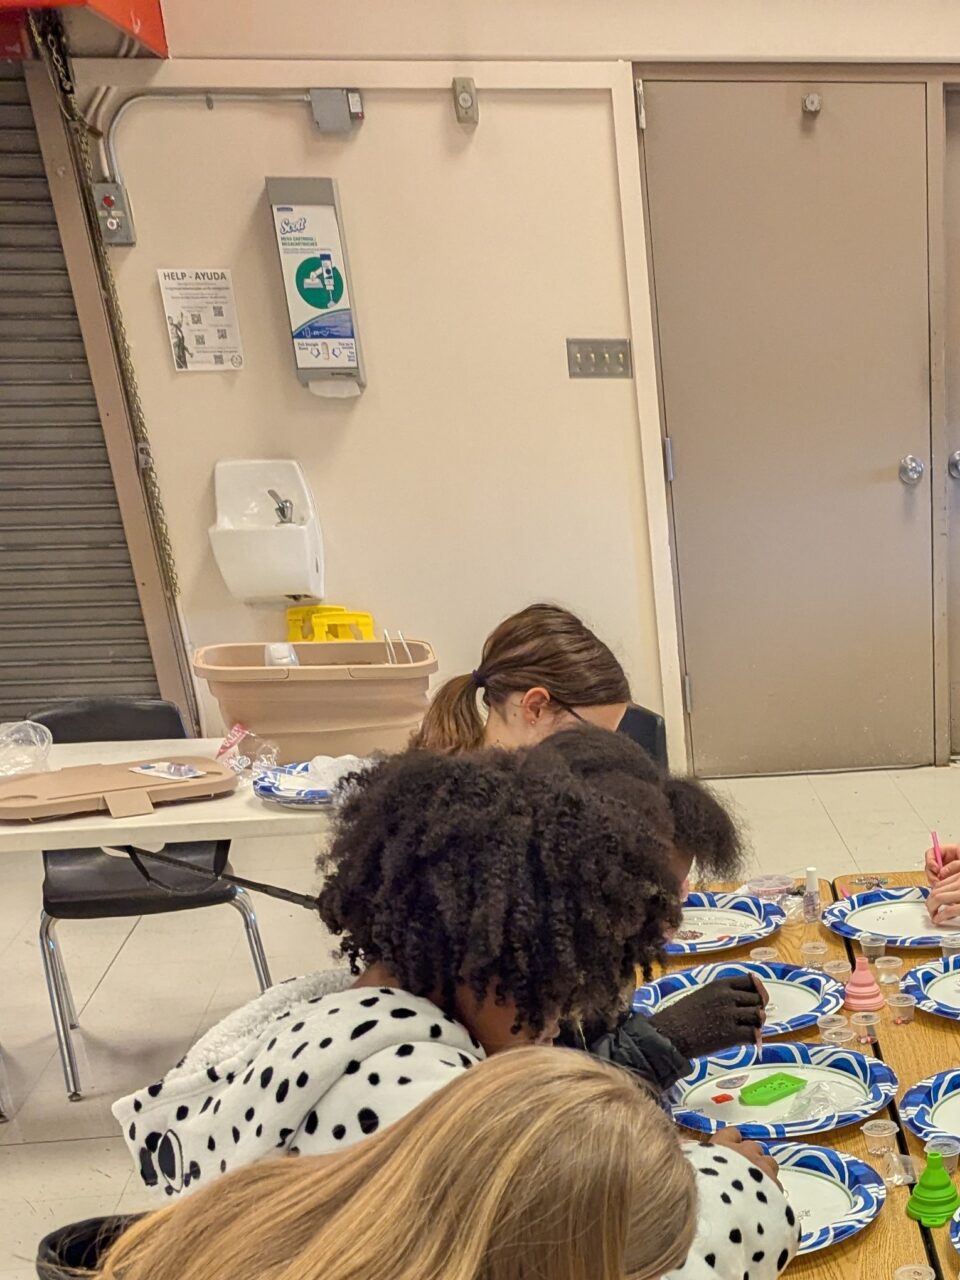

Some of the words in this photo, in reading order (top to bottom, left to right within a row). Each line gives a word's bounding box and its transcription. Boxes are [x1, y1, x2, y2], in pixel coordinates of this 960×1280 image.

[280, 217, 306, 235] Scott
[163, 272, 187, 281] HELP
[195, 271, 227, 281] AYUDA
